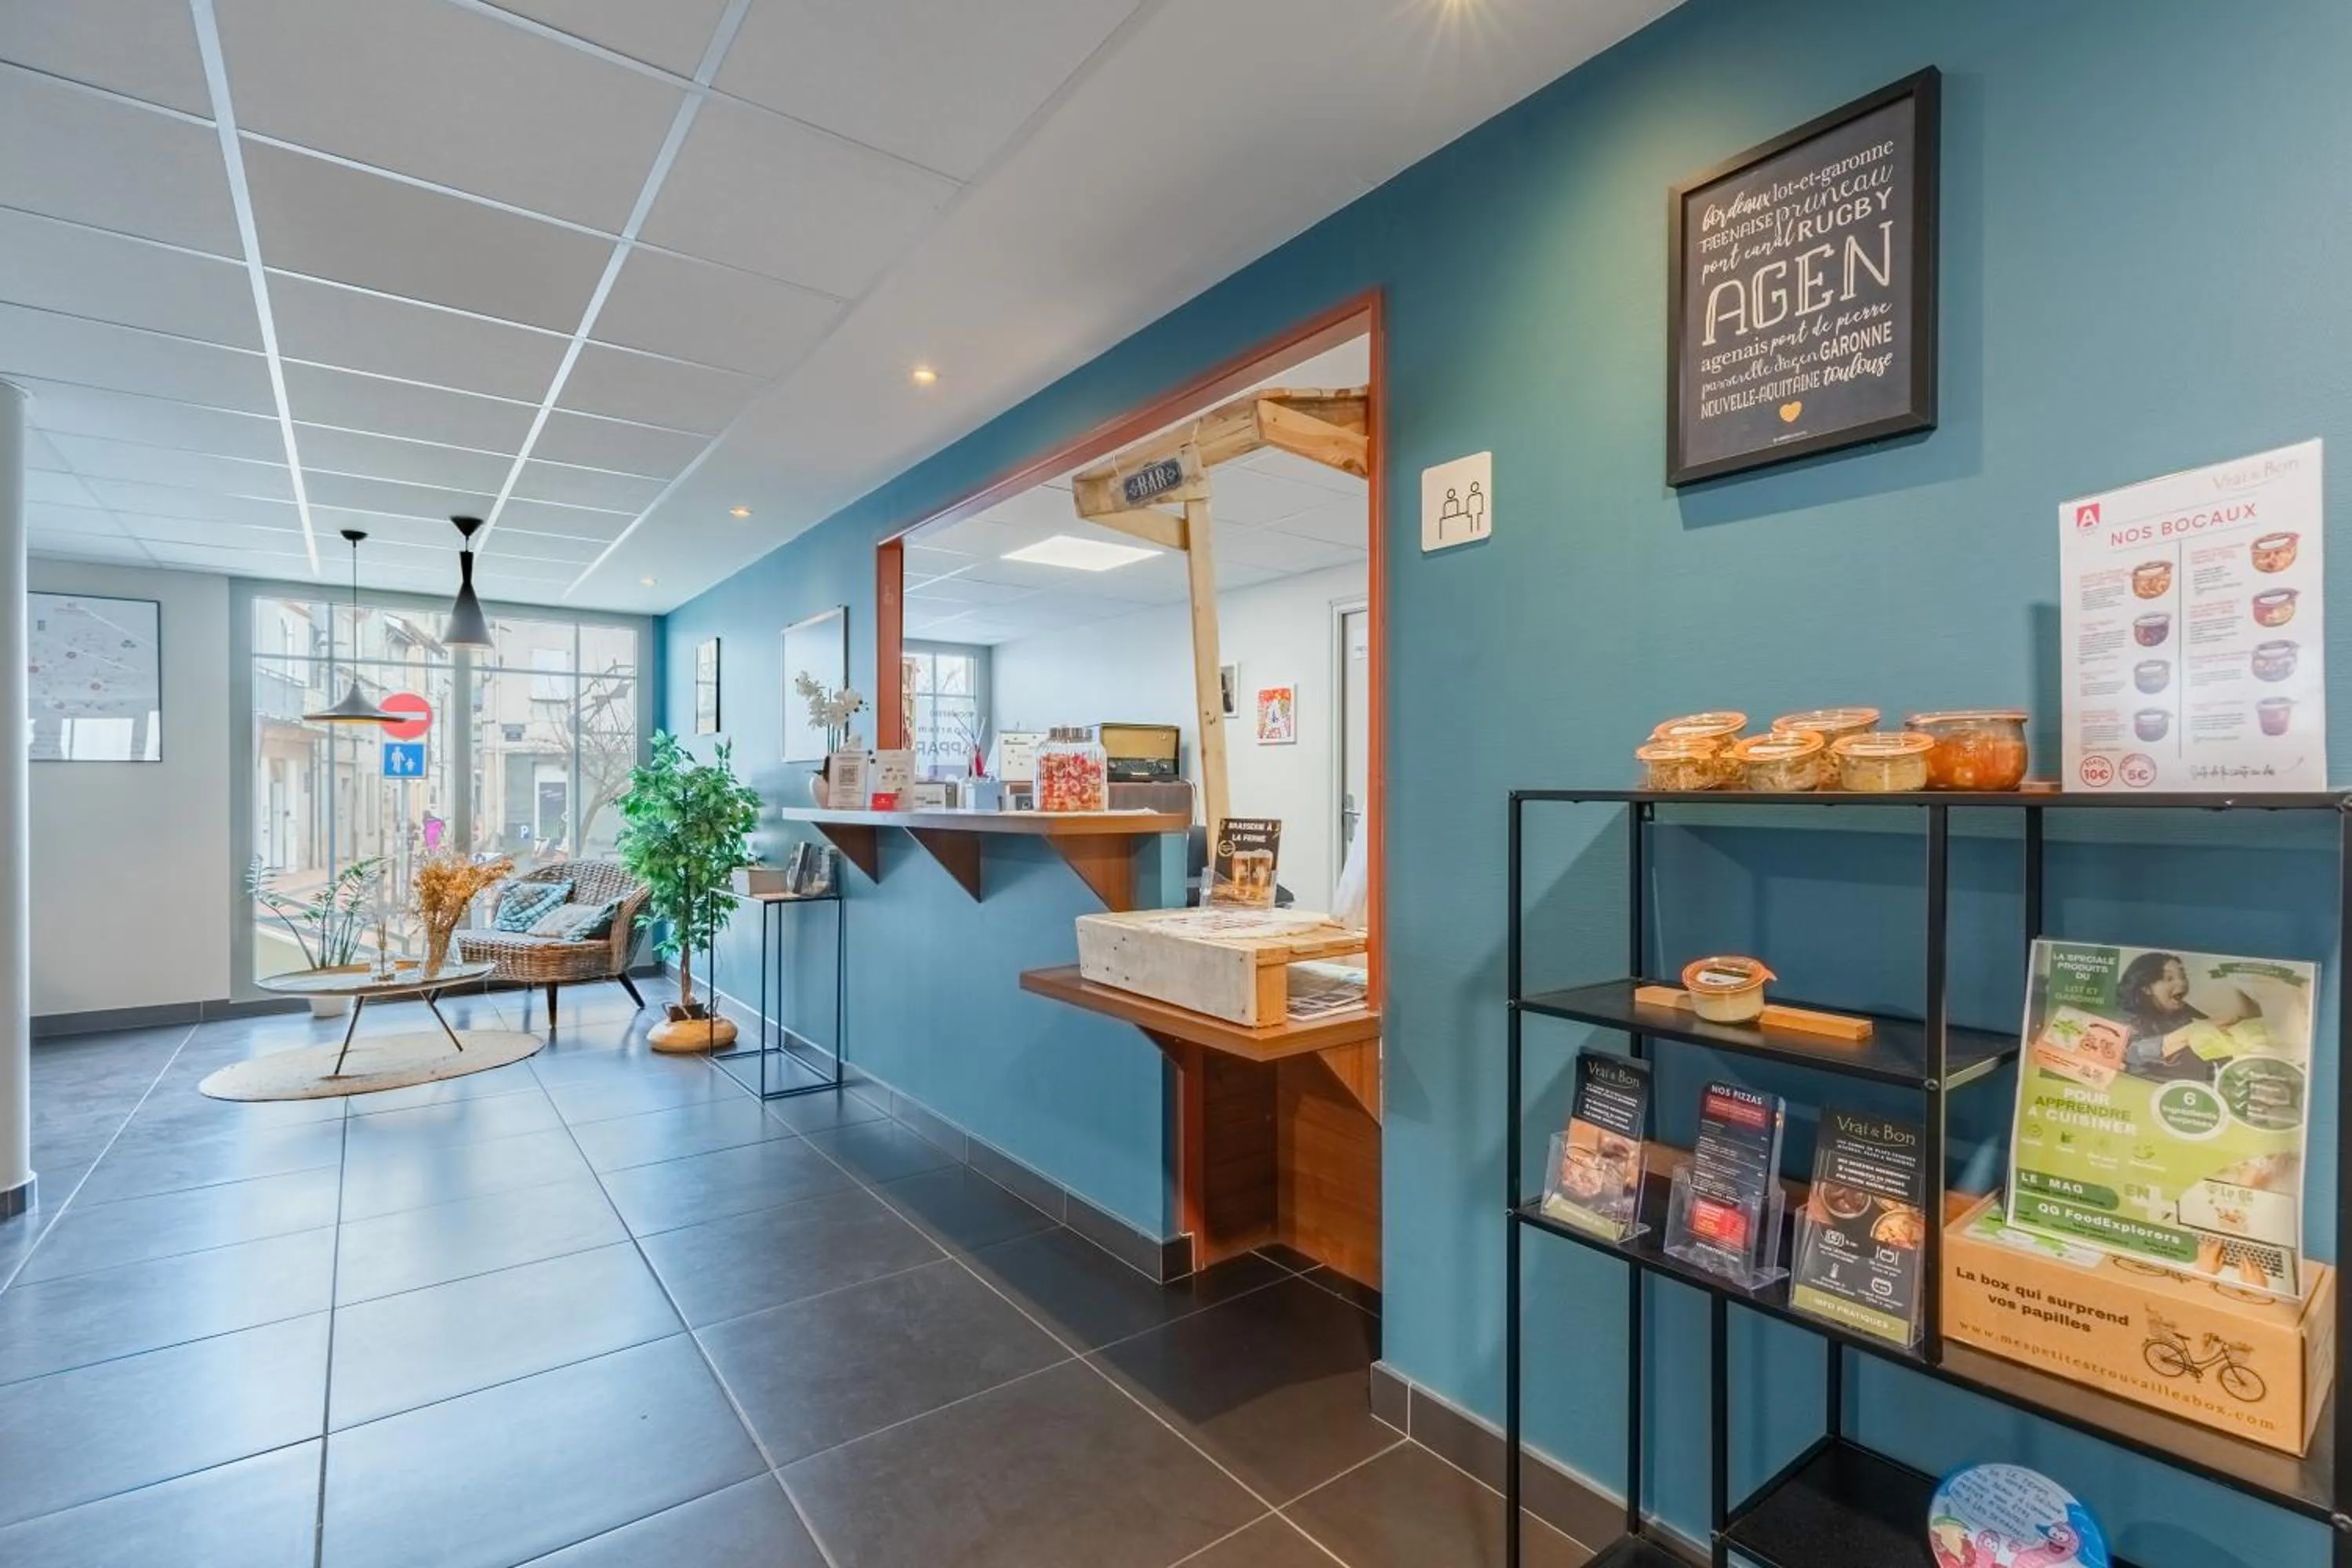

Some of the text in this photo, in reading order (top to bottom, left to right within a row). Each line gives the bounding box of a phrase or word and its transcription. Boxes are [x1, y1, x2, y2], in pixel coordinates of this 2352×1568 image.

[1702, 140, 1893, 231] bordeaux lot-et-garonne
[1699, 164, 1893, 253] AGENAISE pruneau
[1702, 186, 1893, 285] pont canal RUGBY
[1702, 220, 1894, 347] AGEN
[1700, 301, 1891, 373] agenais pont de pierre
[1701, 355, 1773, 400] passerelle
[1820, 321, 1893, 361] GARONNE
[1701, 352, 1893, 419] NOUVELLE-AQUITAINE toulouse
[1138, 466, 1167, 496] BAR
[2111, 503, 2256, 546] NOS BOCAUX
[1618, 1069, 1639, 1087] Bon
[1711, 1084, 1762, 1105] NOS PIZZAS
[2035, 1095, 2132, 1122] APPRENDRE
[2183, 1092, 2196, 1105] 6
[1838, 1116, 1868, 1135] Vrai
[1884, 1123, 1915, 1145] Bon
[2046, 1108, 2137, 1136] CUISINER
[2021, 1172, 2038, 1184] LE
[2124, 1183, 2151, 1199] EN
[2064, 1209, 2180, 1244] FoodExplorers
[1956, 1266, 2129, 1327] La box qui surprend
[1987, 1294, 2092, 1333] vos papilles
